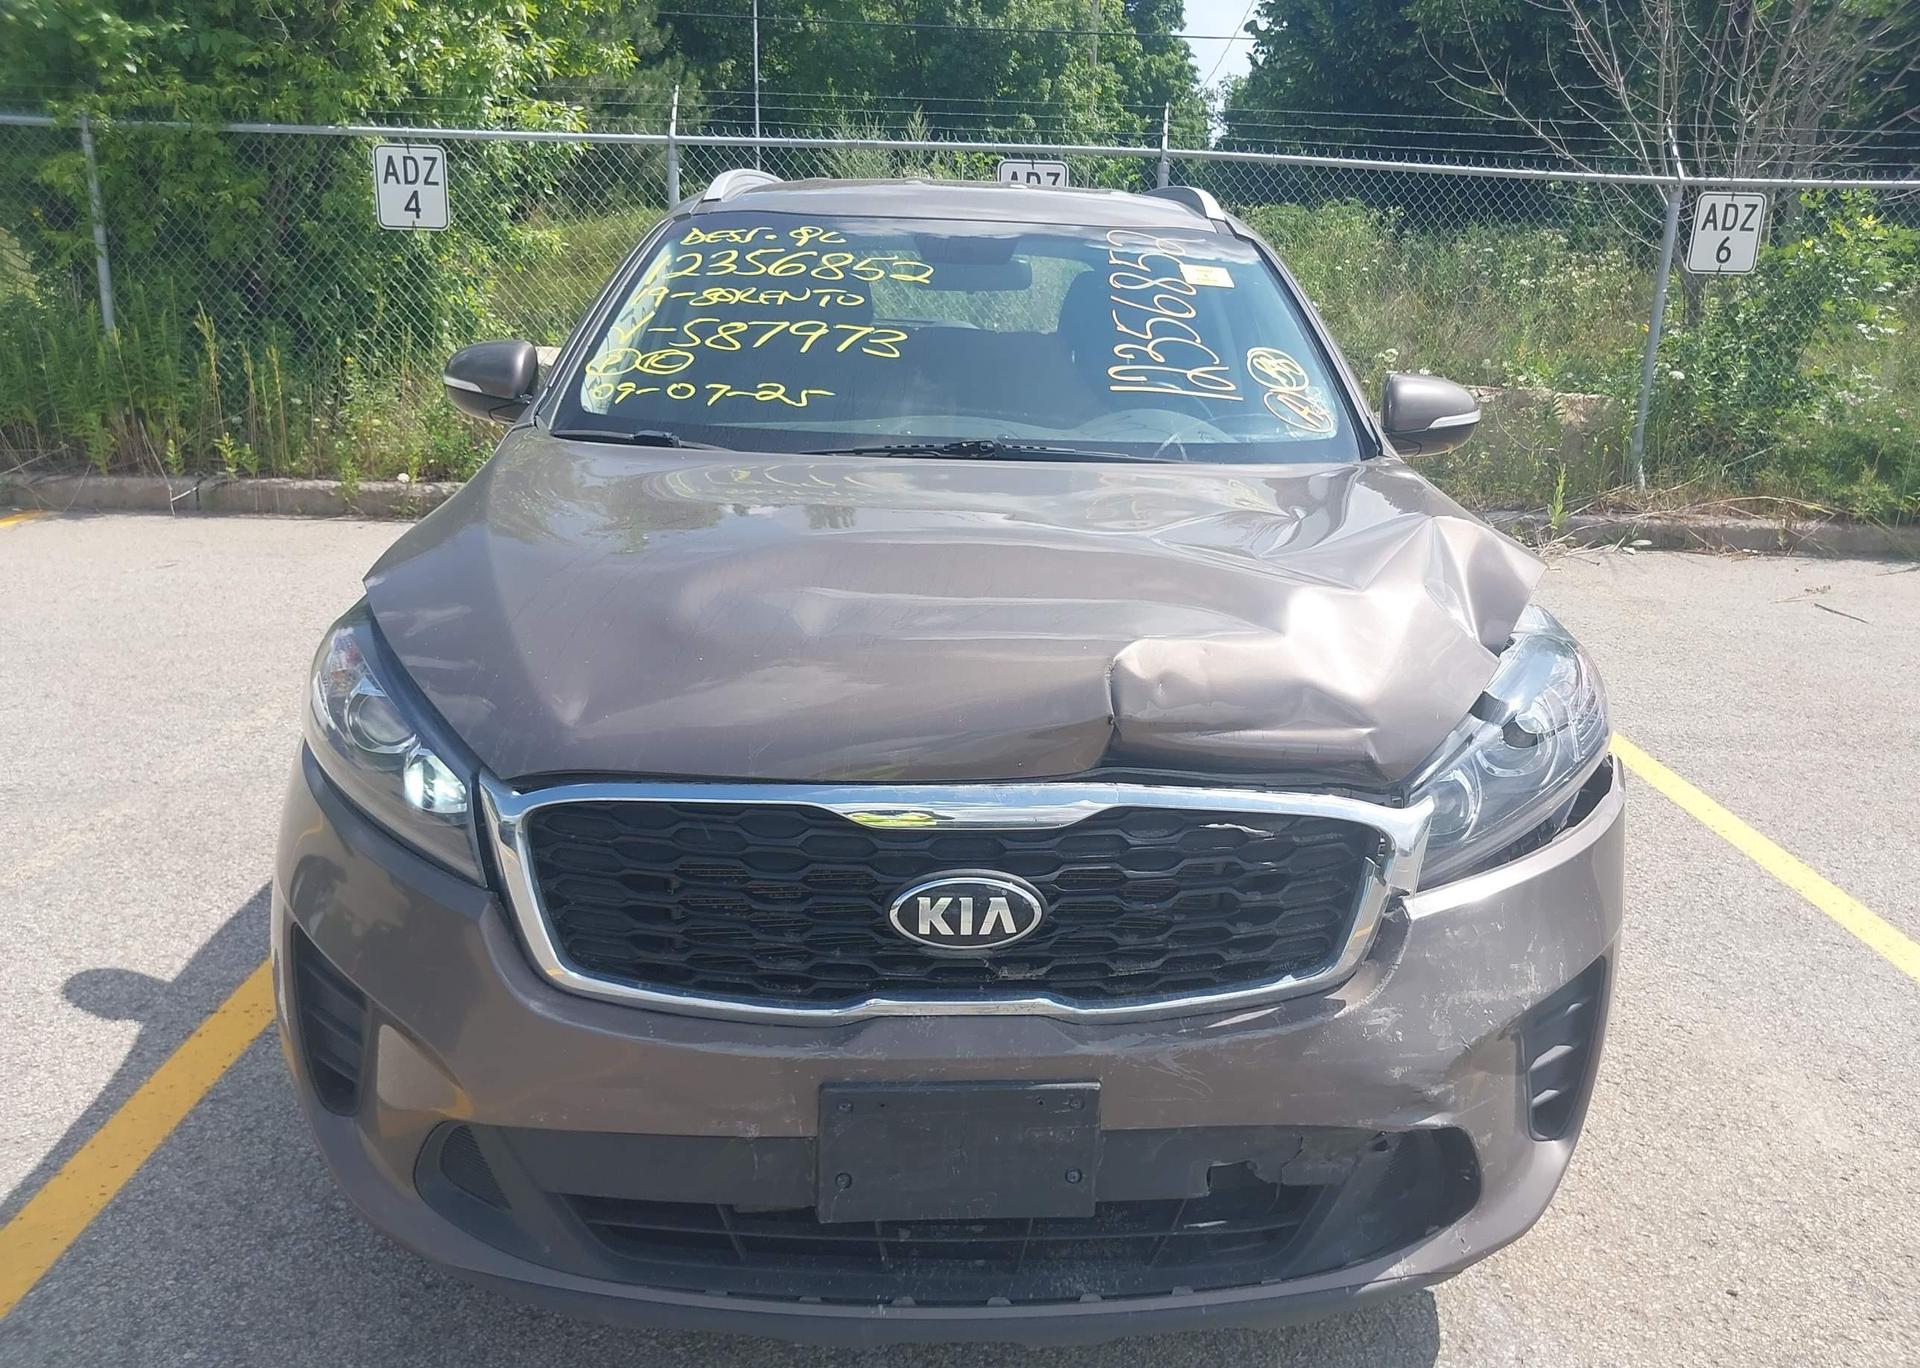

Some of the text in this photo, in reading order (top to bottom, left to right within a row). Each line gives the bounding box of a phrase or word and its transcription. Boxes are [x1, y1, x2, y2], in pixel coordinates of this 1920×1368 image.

[383, 155, 440, 186] ADZ
[404, 190, 421, 219] 4
[1700, 203, 1758, 231] ADZ
[1715, 236, 1731, 263] 6
[917, 896, 1018, 936] KIA
